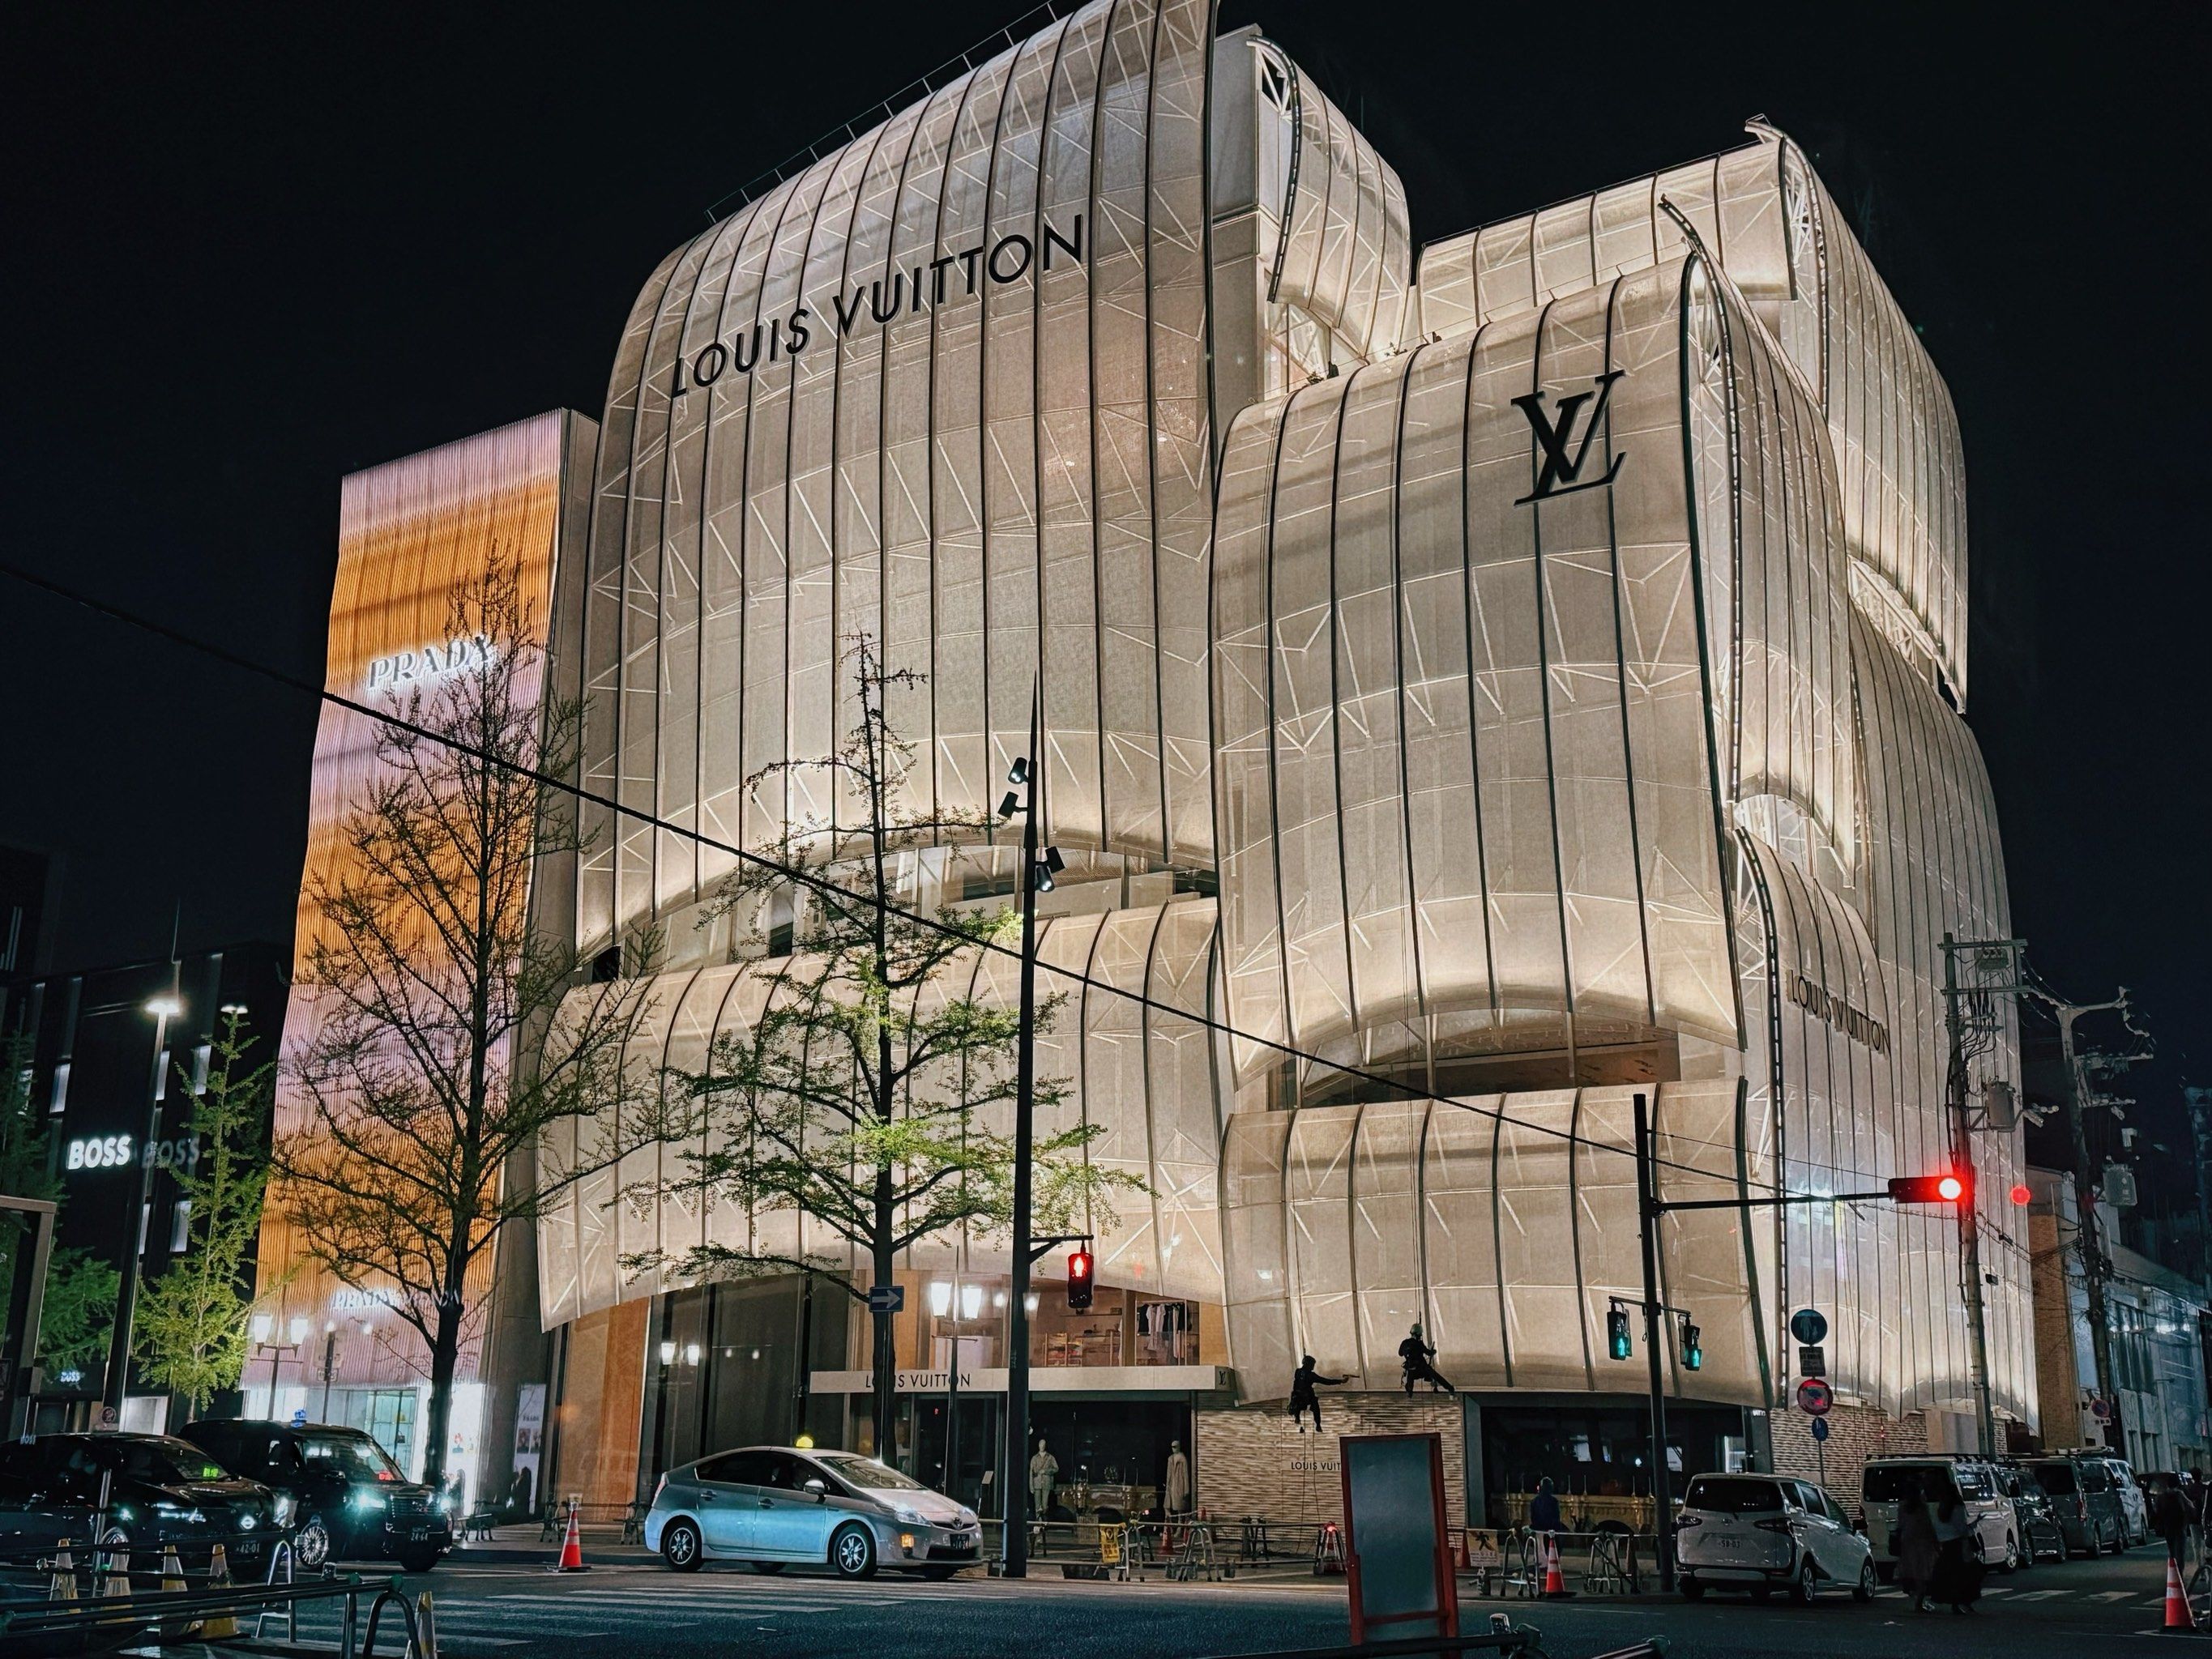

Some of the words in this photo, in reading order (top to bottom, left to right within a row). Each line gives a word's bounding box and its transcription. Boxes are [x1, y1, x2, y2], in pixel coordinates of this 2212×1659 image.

[671, 308, 810, 398] LOUIS
[831, 214, 1084, 339] VUITTON
[1785, 969, 1832, 1023] LOUIS
[1830, 996, 1892, 1060] VUITTON
[67, 1135, 132, 1170] BOSS
[1291, 1461, 1317, 1471] LOUIS
